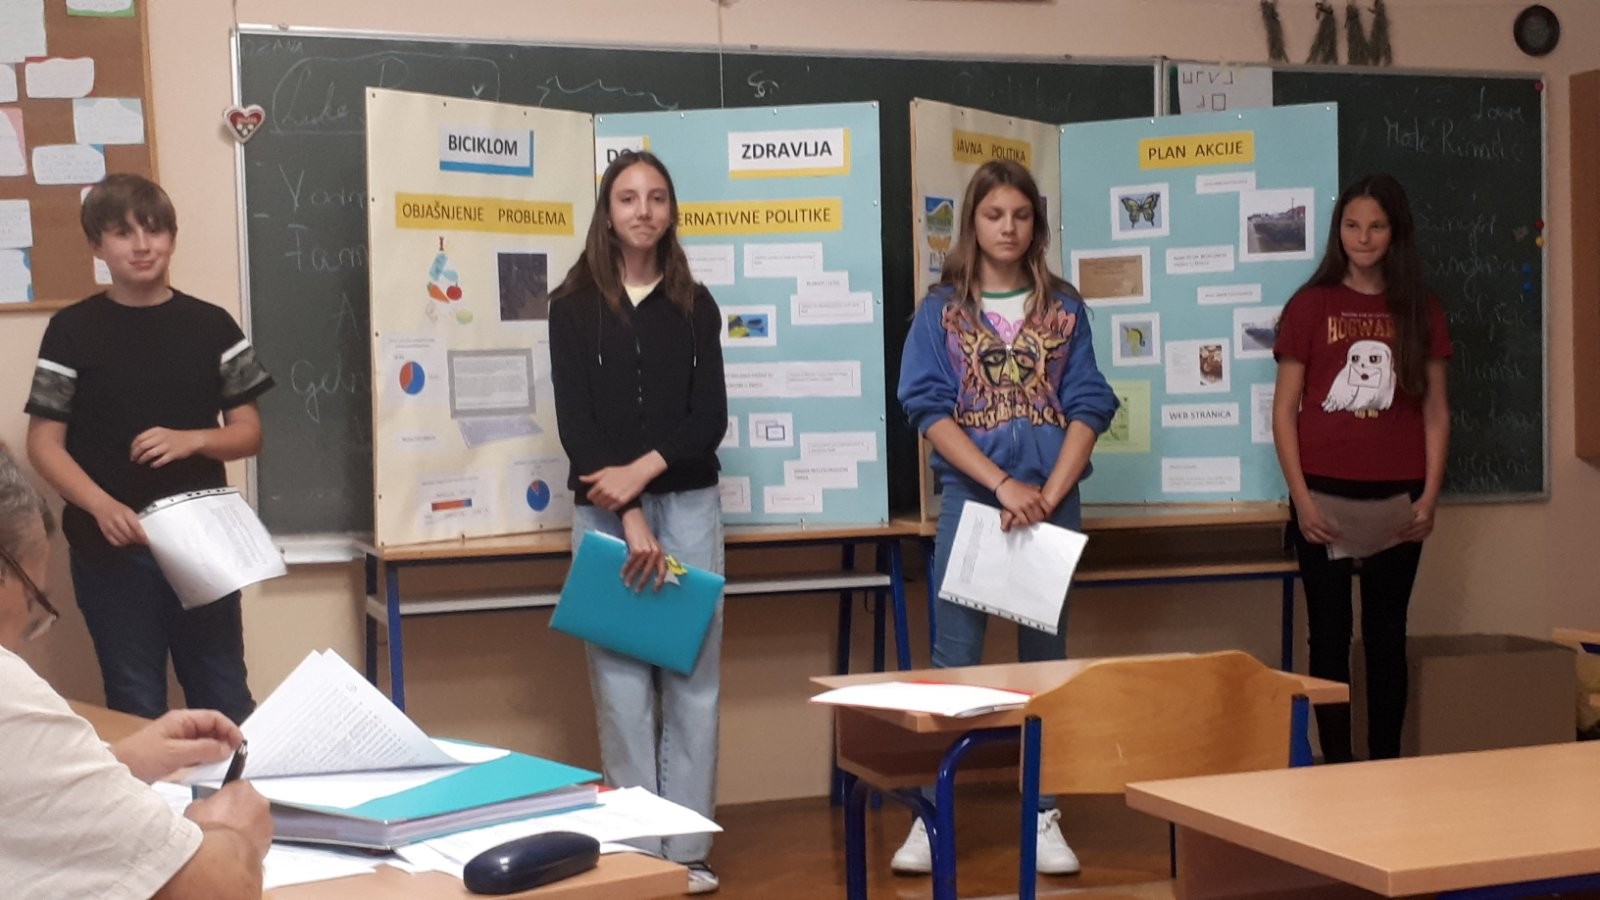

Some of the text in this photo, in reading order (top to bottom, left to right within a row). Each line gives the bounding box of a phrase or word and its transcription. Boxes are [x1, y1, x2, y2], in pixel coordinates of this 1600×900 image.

[448, 134, 519, 156] BICIKLOM
[741, 140, 833, 160] ZDRAVLJA
[956, 138, 1026, 162] JAVNA POLITIKA
[1147, 140, 1244, 161] PLAN AKCIJE
[402, 201, 567, 226] OBJAŠNJENJE PROBLEMA
[677, 207, 832, 227] ERNATIVNE POLITIKE
[1327, 315, 1396, 345] HOGWAR
[1169, 410, 1232, 420] WEB STRANICA
